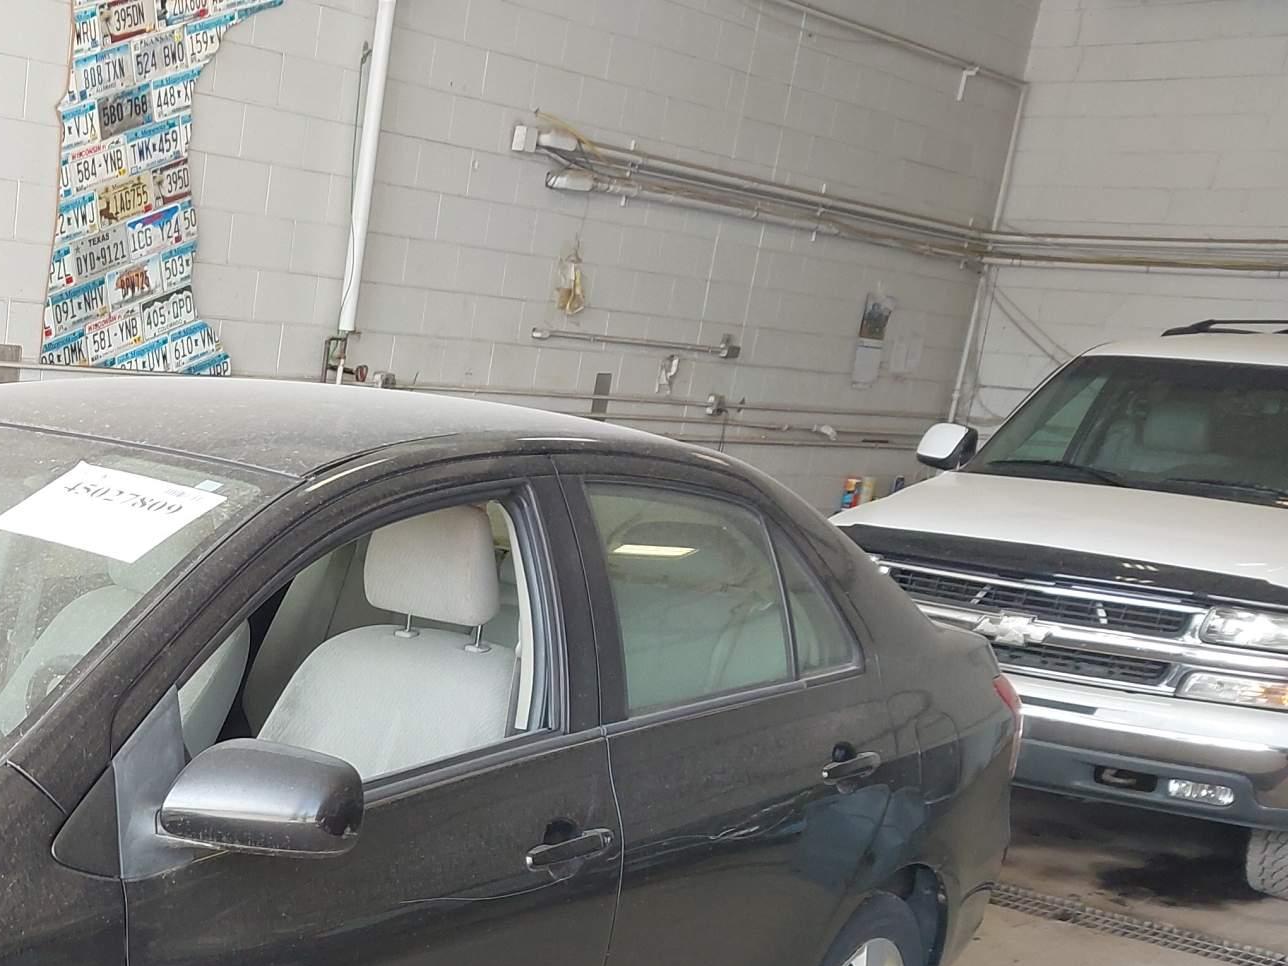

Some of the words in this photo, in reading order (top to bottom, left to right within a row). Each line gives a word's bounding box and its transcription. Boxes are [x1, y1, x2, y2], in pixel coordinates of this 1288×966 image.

[105, 55, 125, 82] TXN
[88, 232, 110, 247] TEXAS
[64, 481, 183, 515] 45027809
